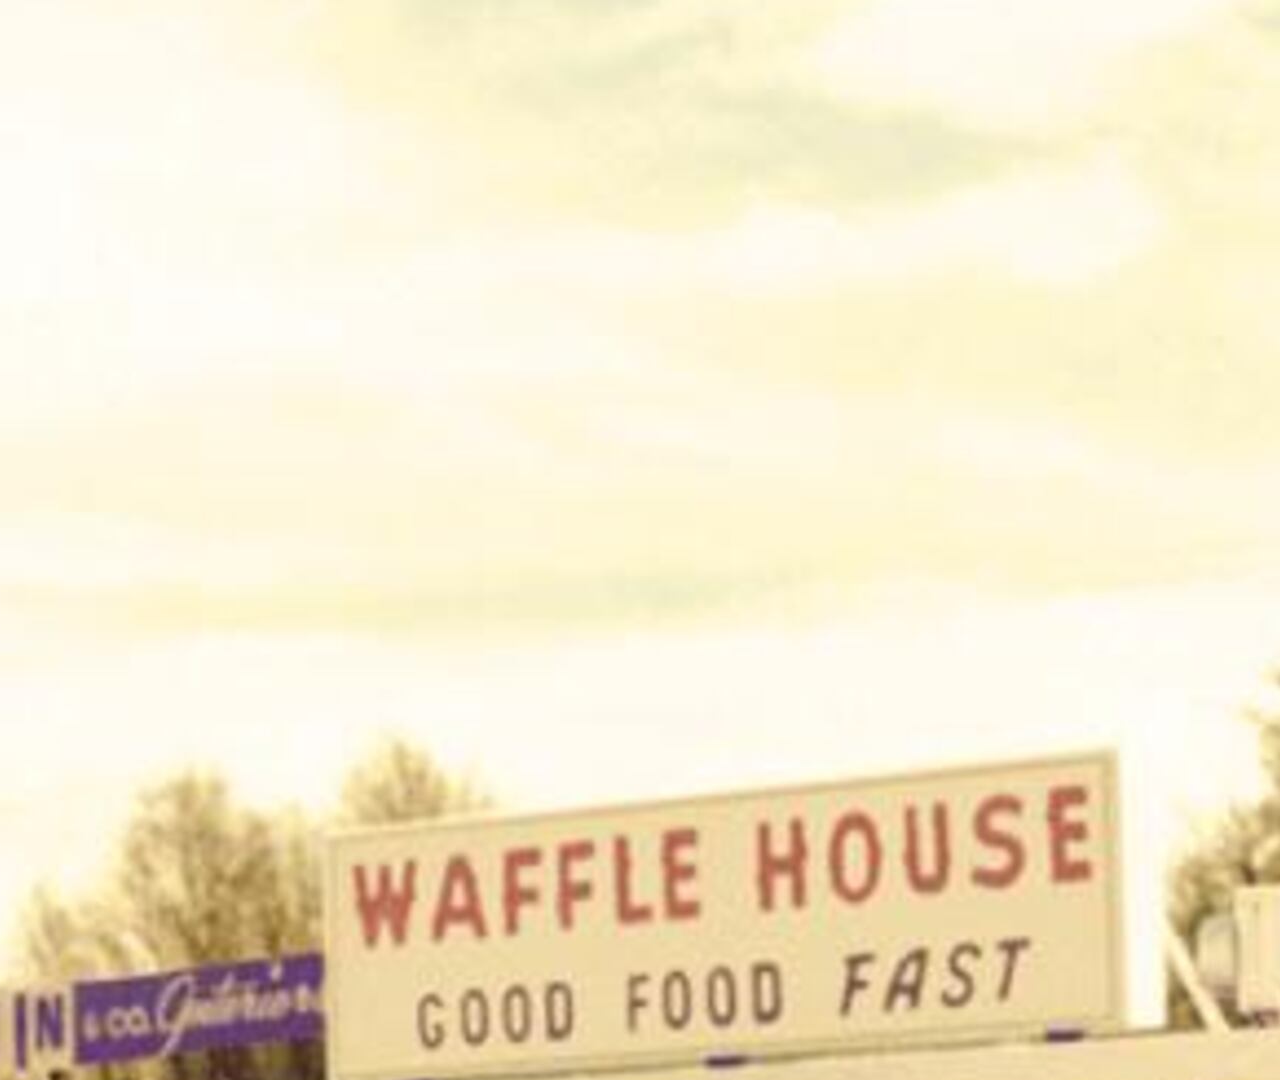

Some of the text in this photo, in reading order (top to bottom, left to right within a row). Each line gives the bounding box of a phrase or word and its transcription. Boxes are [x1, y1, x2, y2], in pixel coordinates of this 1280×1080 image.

[352, 786, 1093, 948] WAFFLE HOUSE
[417, 938, 1032, 1050] GOOD FOOD FAST
